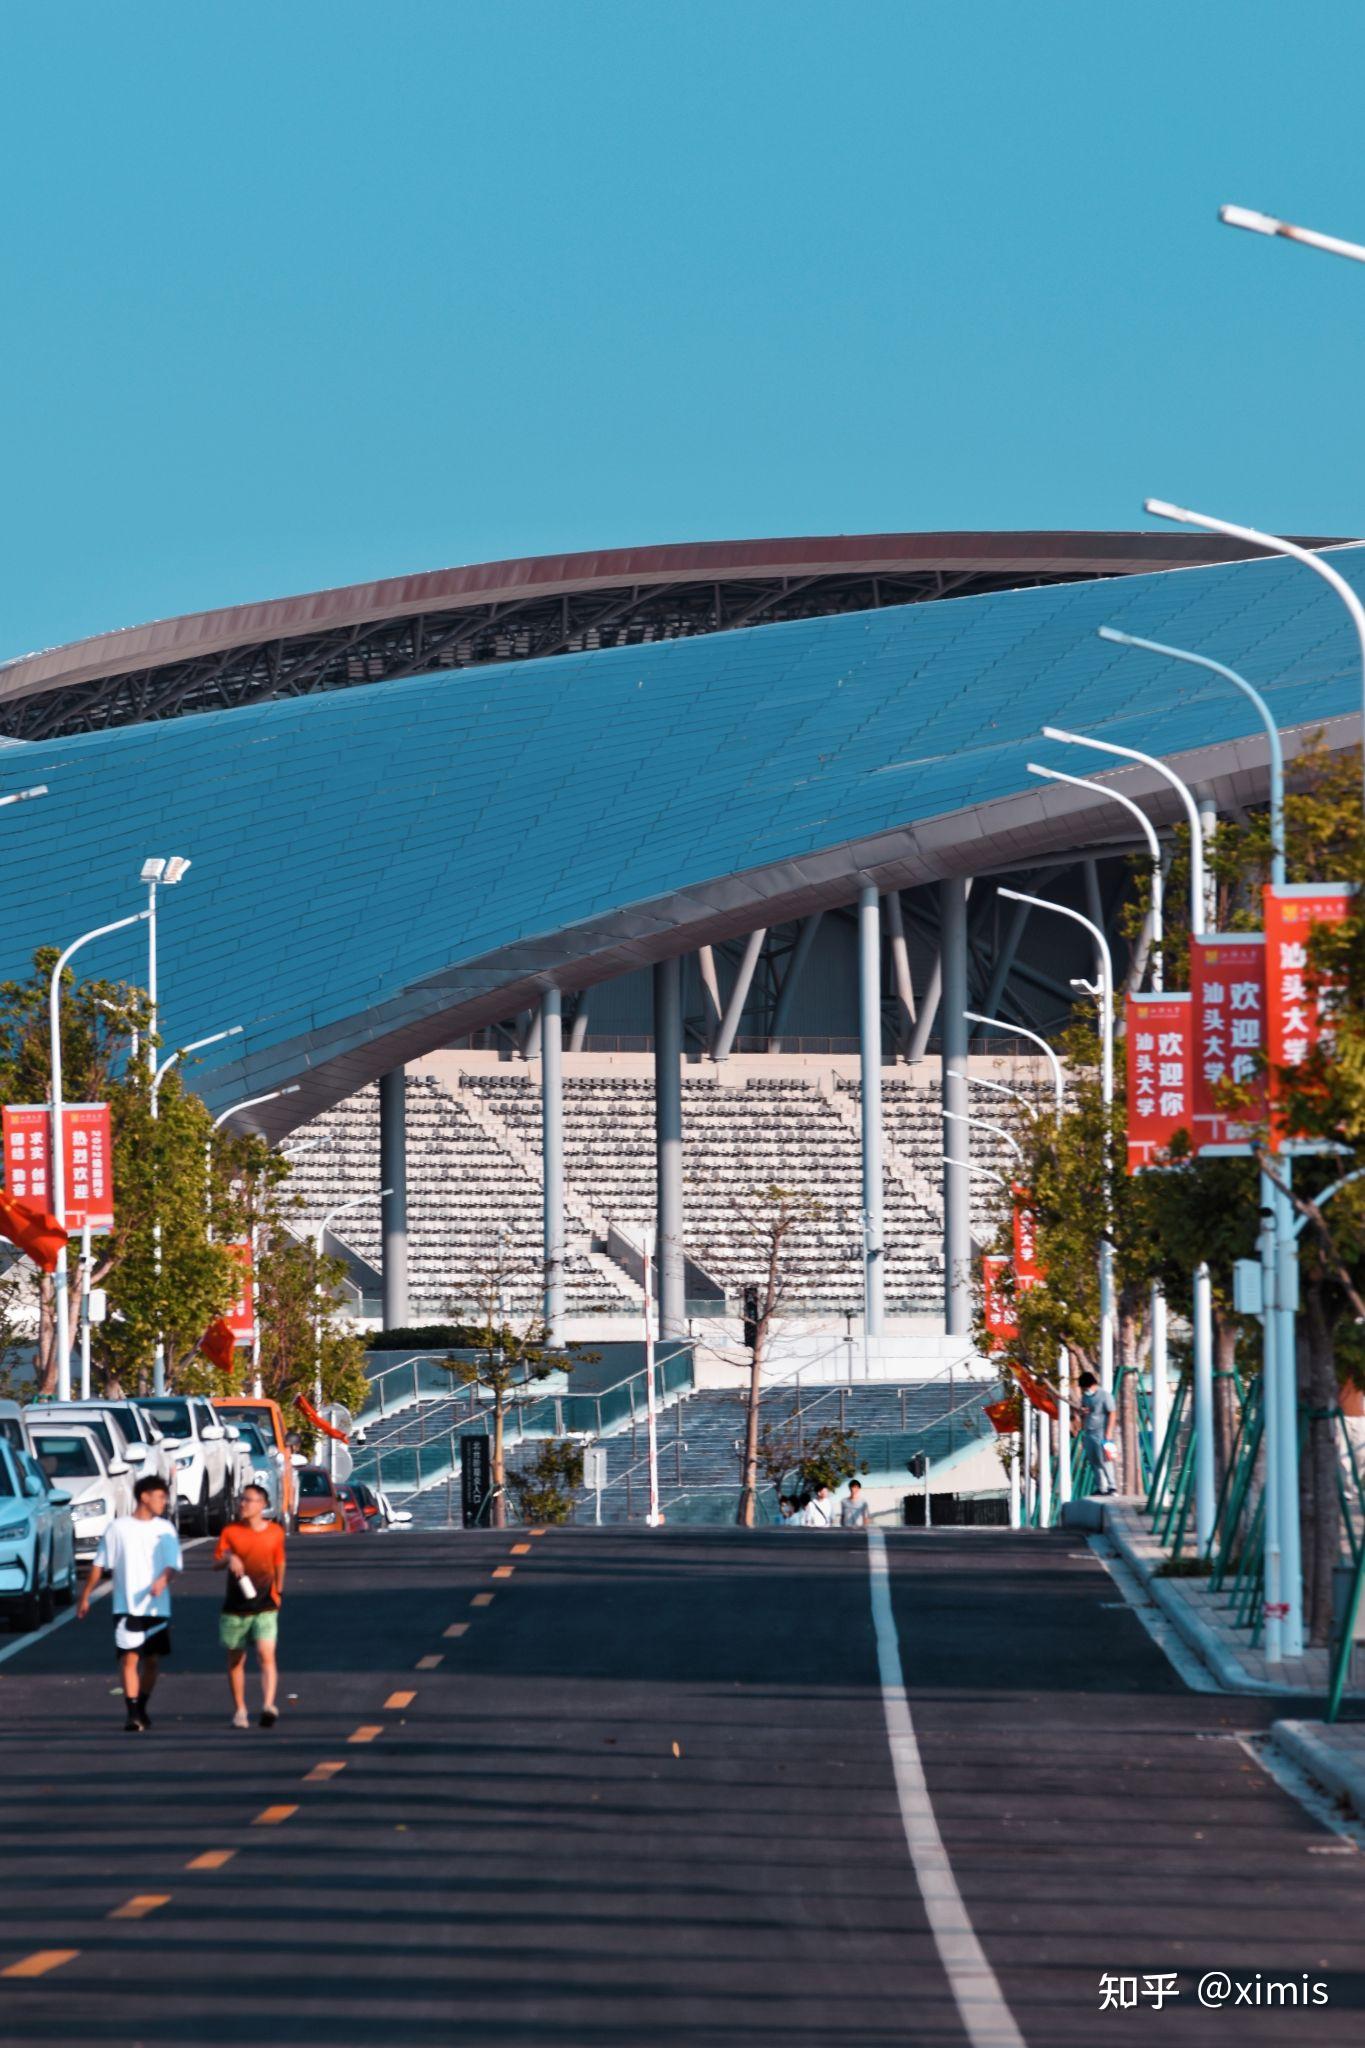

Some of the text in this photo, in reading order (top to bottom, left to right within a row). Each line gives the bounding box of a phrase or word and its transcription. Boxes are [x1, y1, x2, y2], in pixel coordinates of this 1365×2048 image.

[1203, 981, 1226, 1085] 汕头大学
[1230, 981, 1260, 1084] 欢迎你
[1279, 942, 1309, 1066] 汕头大学
[1135, 1032, 1155, 1117] 汕头大学
[1158, 1032, 1184, 1117] 欢迎你
[72, 1130, 89, 1199] 热烈欢迎
